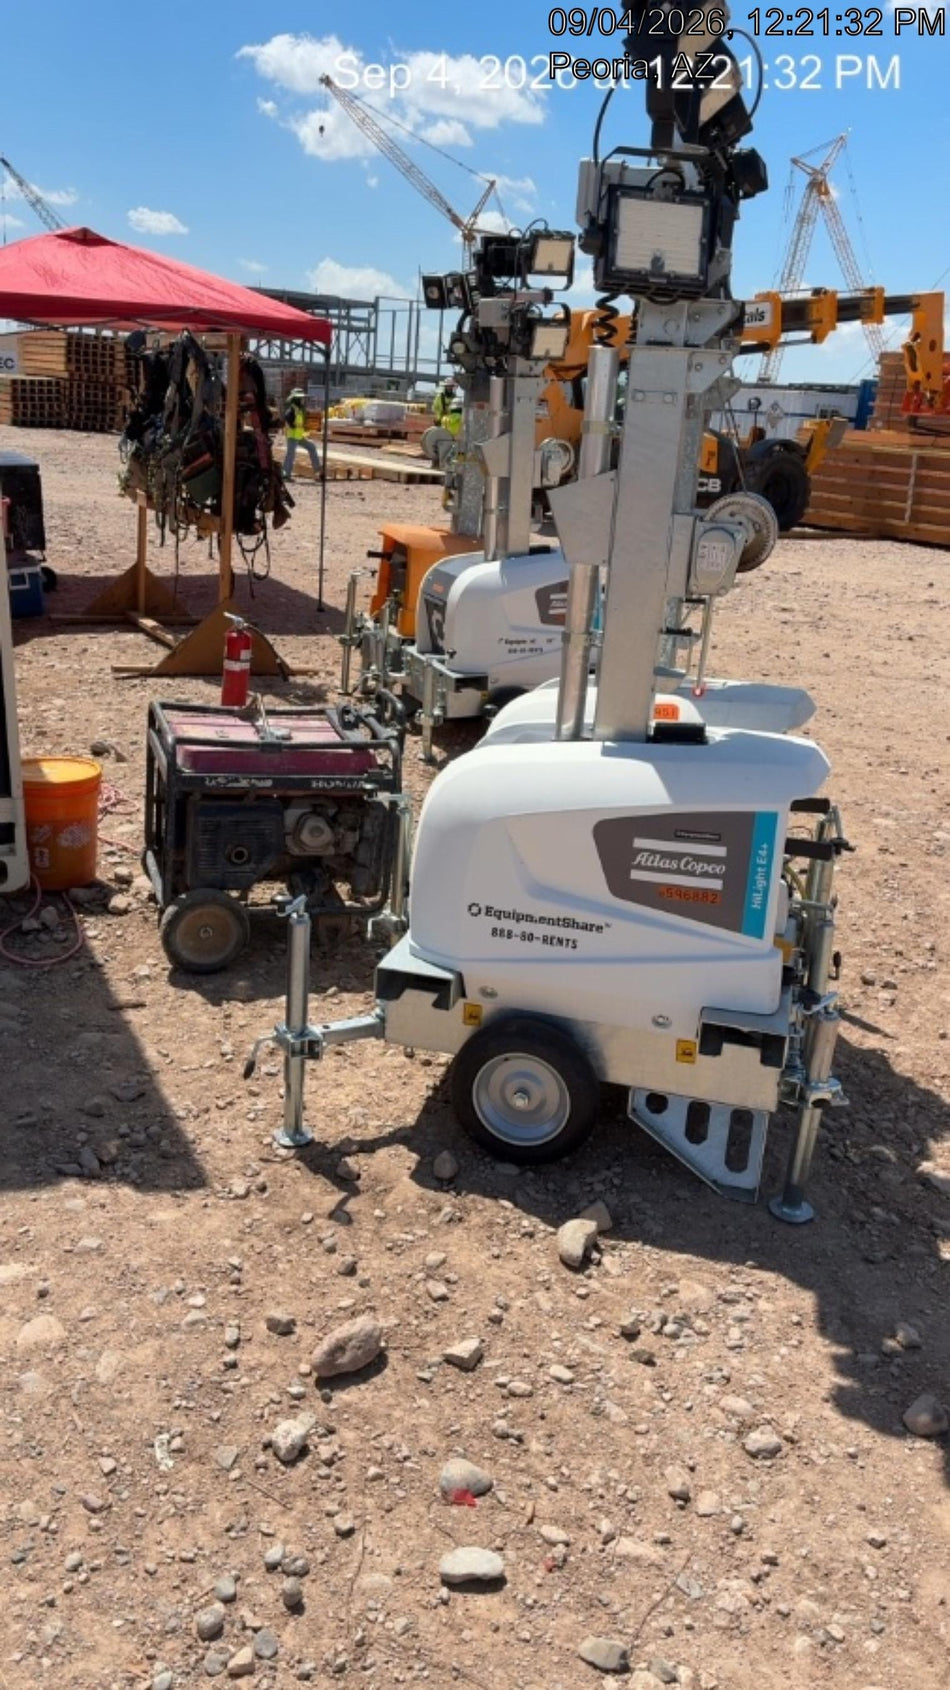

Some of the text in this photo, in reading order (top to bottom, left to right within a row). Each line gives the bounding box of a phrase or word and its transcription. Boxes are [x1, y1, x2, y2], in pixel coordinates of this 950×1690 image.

[632, 851, 726, 876] Atlas Copco
[490, 926, 578, 950] 888-80-RENTS
